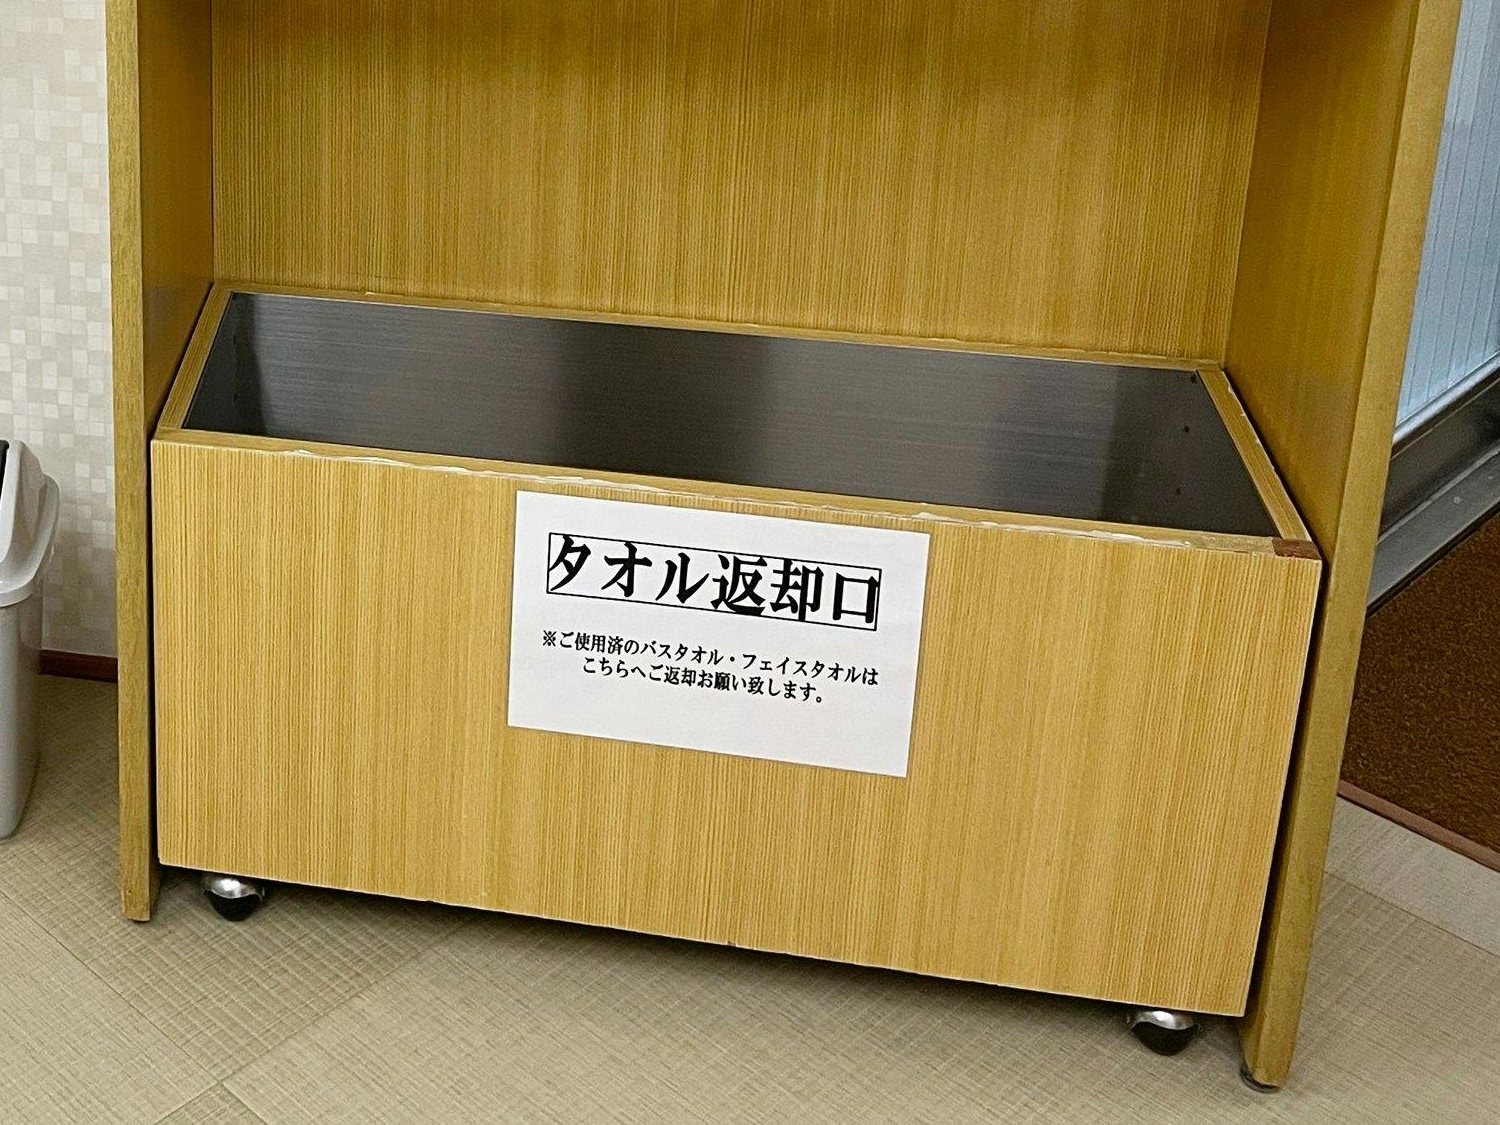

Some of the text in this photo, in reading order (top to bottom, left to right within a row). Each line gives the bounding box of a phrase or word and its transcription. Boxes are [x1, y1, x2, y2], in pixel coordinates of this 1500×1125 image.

[549, 535, 879, 623] タオル返却口
[543, 629, 879, 686] ※ご使用済のバスタオル・フェイスタオルは
[582, 657, 823, 703] こちらへご返却お願い致します。
